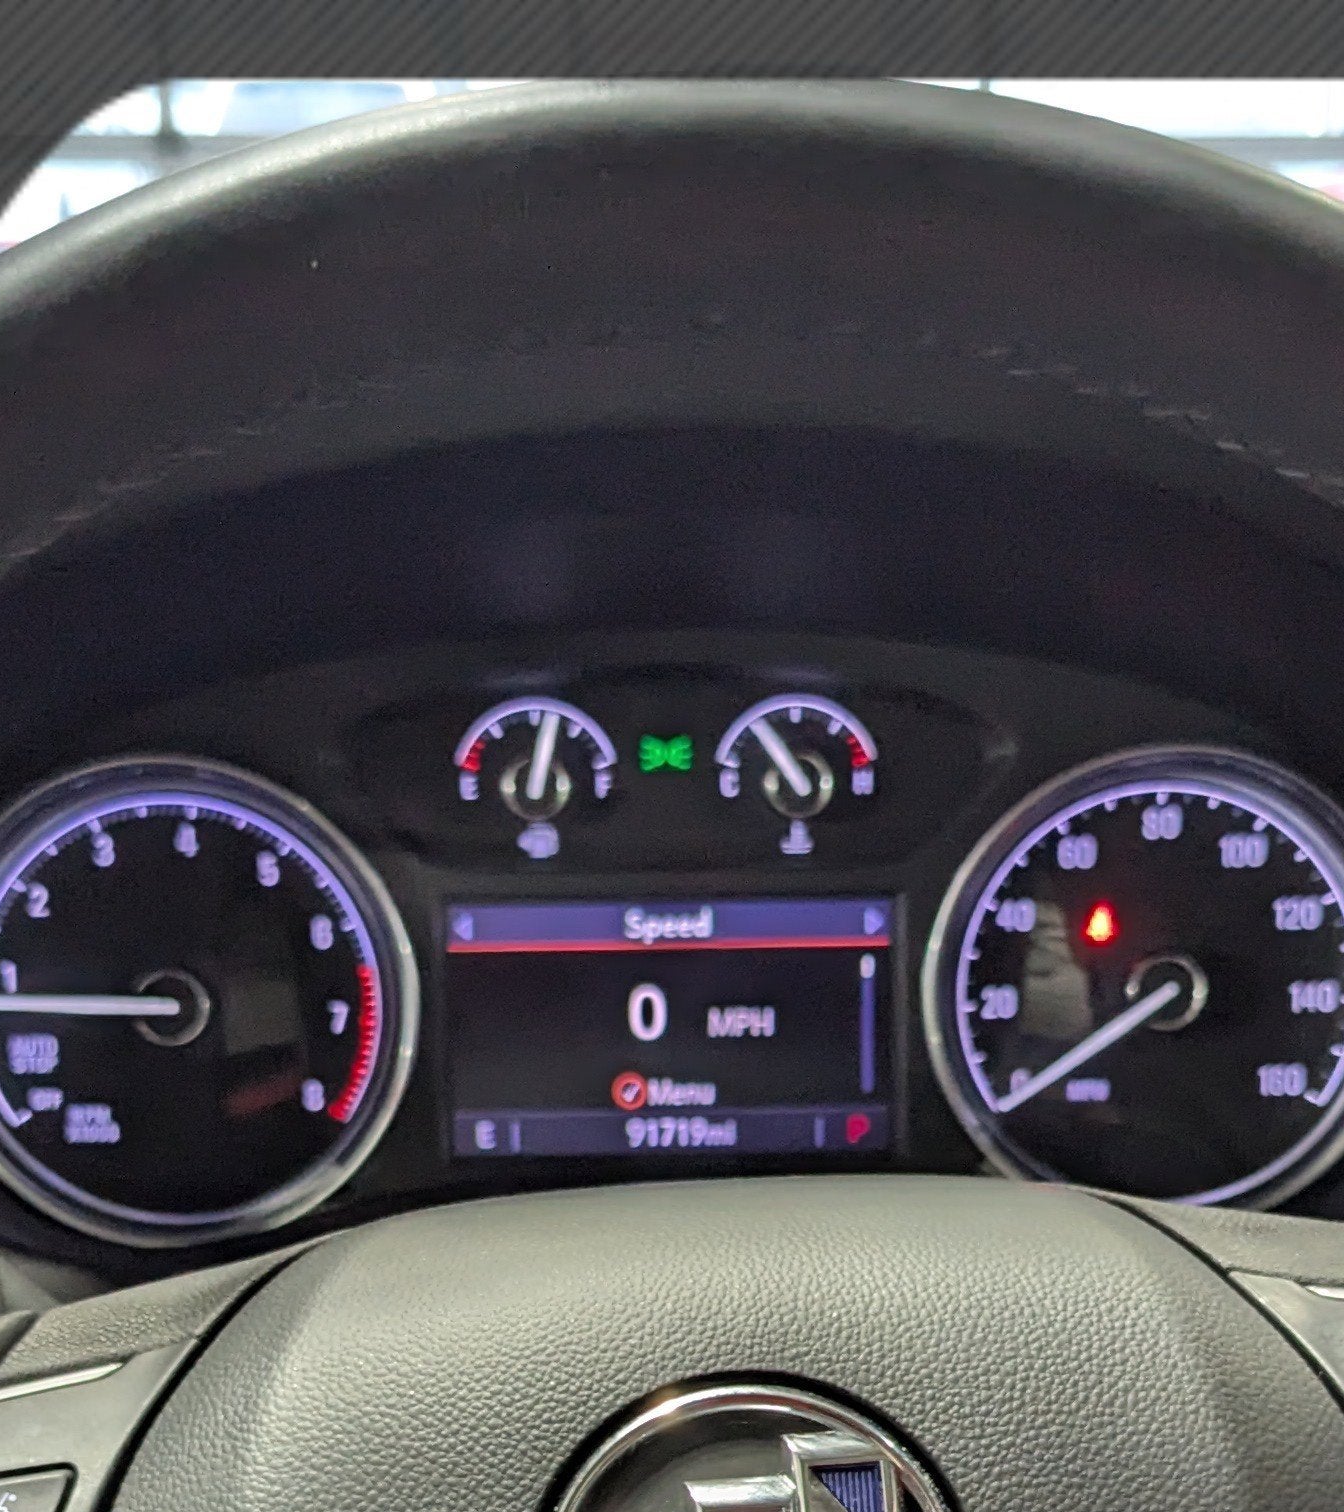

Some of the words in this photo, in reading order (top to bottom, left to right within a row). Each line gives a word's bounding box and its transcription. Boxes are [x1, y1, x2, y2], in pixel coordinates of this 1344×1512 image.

[460, 773, 479, 800] E
[595, 771, 612, 798] F
[719, 768, 740, 797] C
[1142, 804, 1183, 839] 80
[92, 832, 115, 866] 3
[174, 822, 199, 857] 4
[1057, 835, 1097, 870] 60
[1220, 834, 1268, 868] 100
[256, 852, 280, 887] 5
[27, 884, 49, 917] 2
[996, 898, 1036, 932] 40
[1273, 896, 1323, 930] 120
[310, 914, 333, 949] 6
[624, 907, 713, 944] Speed
[0, 960, 17, 992] 1
[628, 984, 667, 1041] 0
[707, 1007, 774, 1037] MPH
[980, 985, 1018, 1019] 20
[1289, 979, 1340, 1014] 140
[329, 1001, 348, 1033] 7
[302, 1080, 324, 1111] 8
[649, 1079, 715, 1106] Menu
[1258, 1063, 1308, 1096] 160
[476, 1120, 496, 1149] E
[847, 1115, 869, 1143] P
